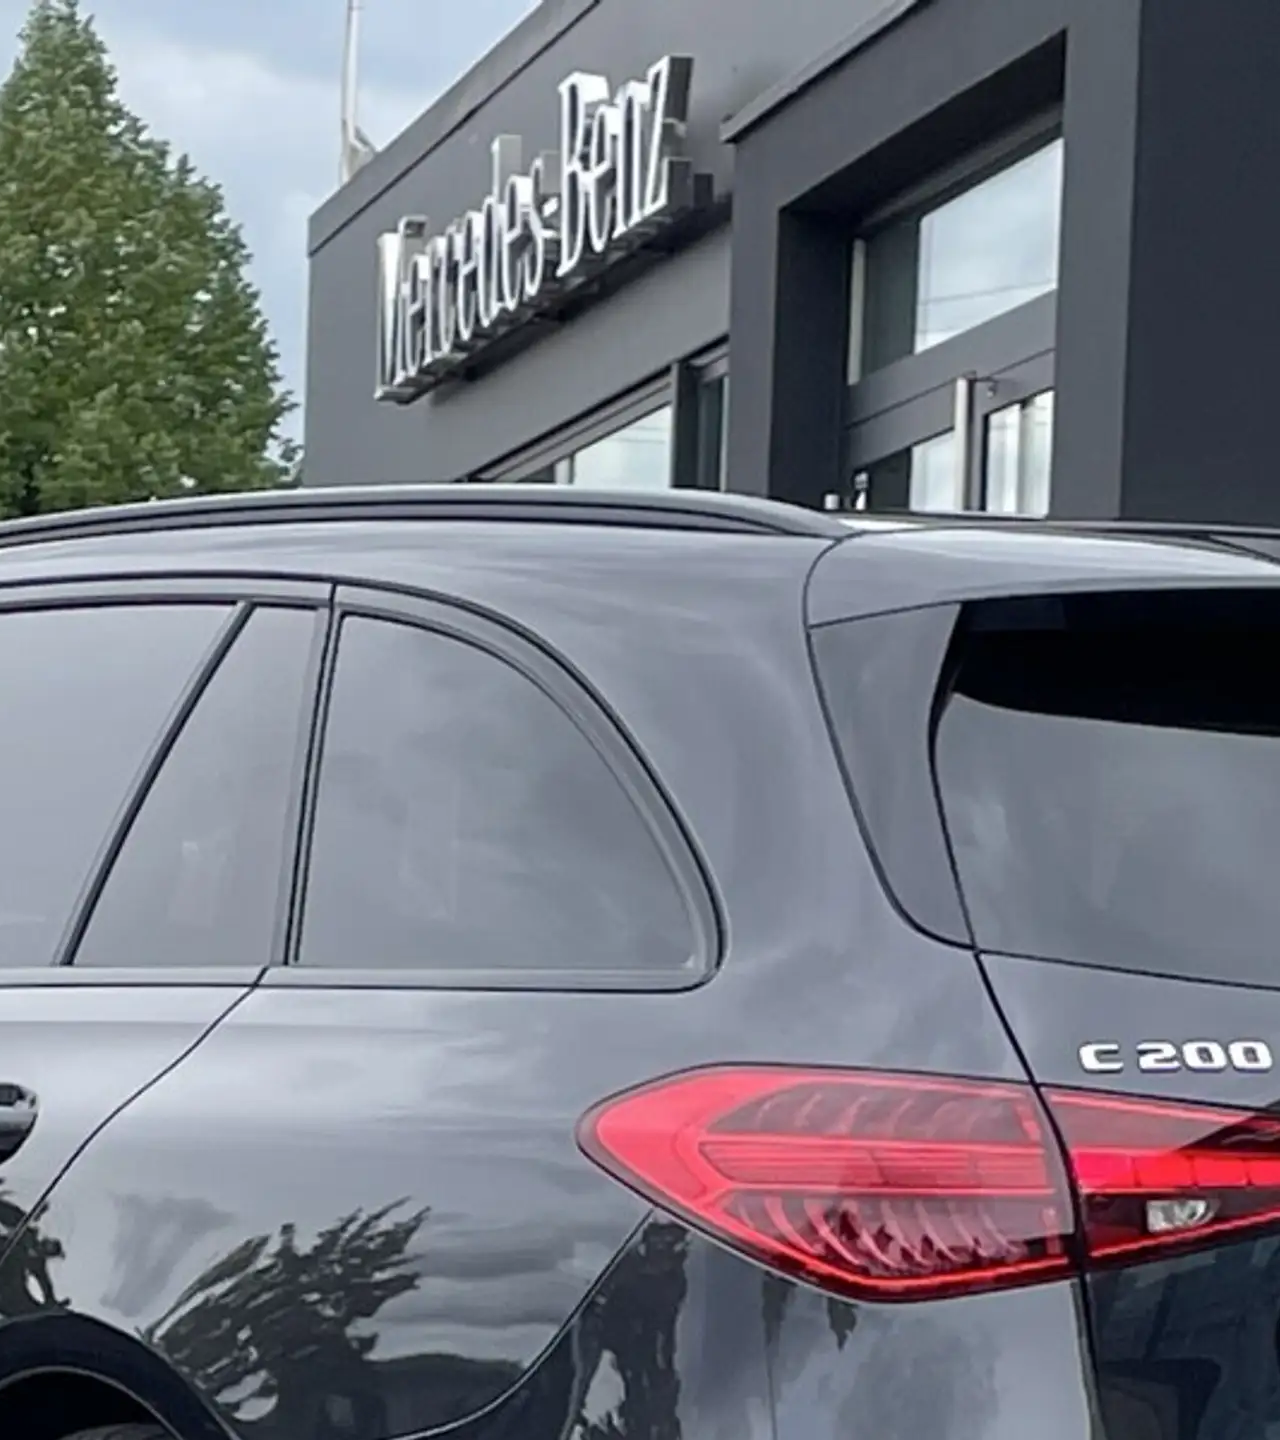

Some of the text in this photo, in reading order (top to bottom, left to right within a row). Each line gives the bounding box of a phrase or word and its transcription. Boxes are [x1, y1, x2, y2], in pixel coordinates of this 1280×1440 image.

[374, 56, 694, 403] Mercedes-Benz
[1078, 1039, 1273, 1072] C 200
